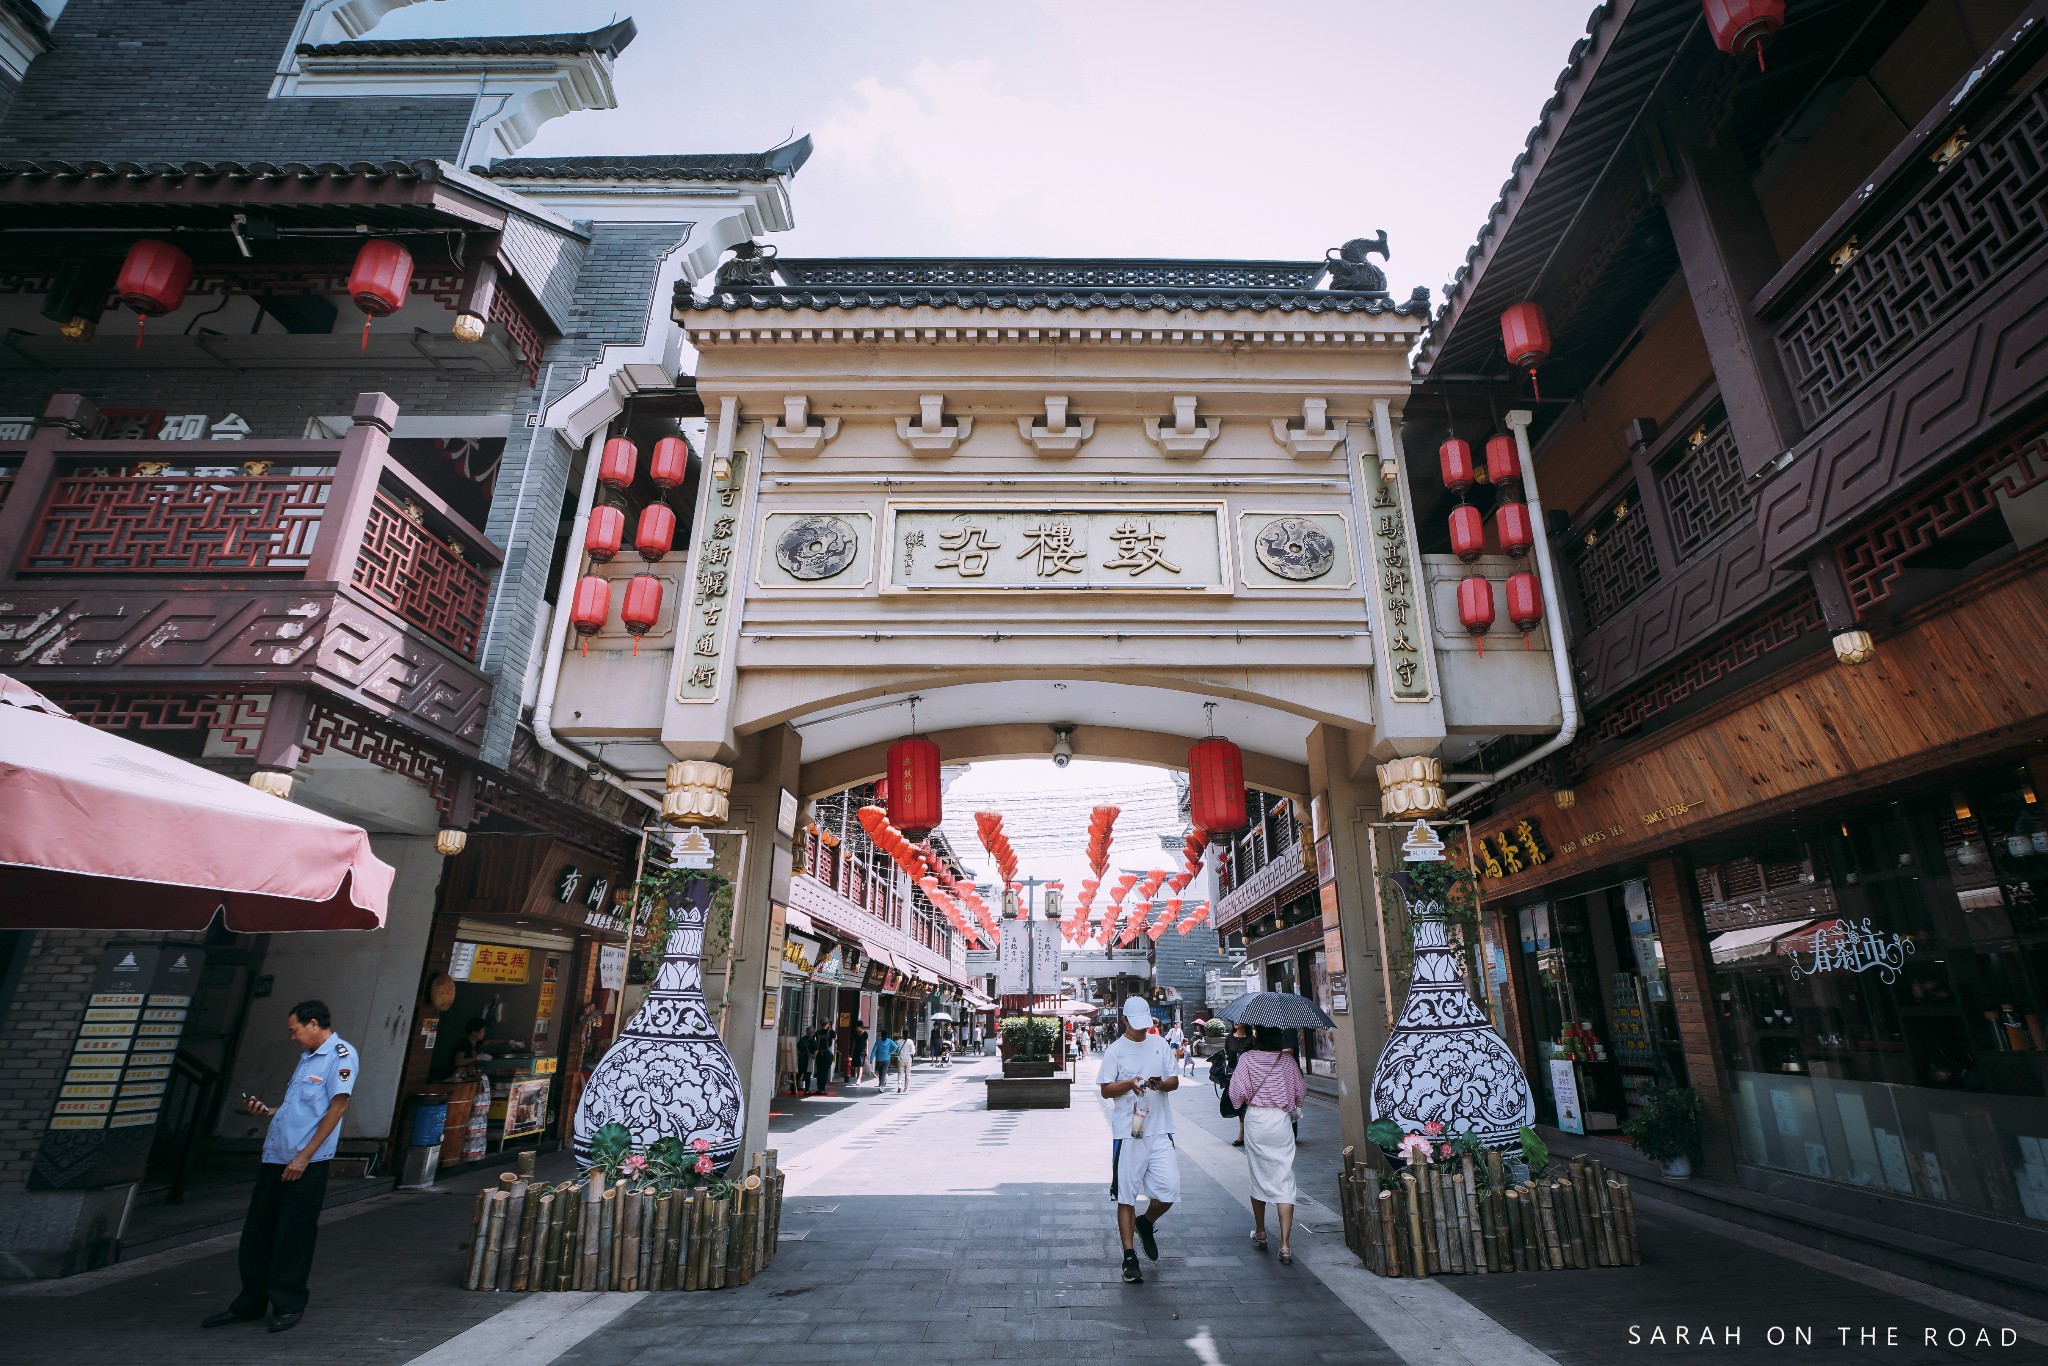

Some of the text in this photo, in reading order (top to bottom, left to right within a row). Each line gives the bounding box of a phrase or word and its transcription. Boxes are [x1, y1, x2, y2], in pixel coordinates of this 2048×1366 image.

[1642, 808, 1668, 826] SINCE
[1580, 831, 1607, 848] HORSES
[1609, 824, 1627, 838] TEA
[476, 948, 526, 969] 宝豆糕
